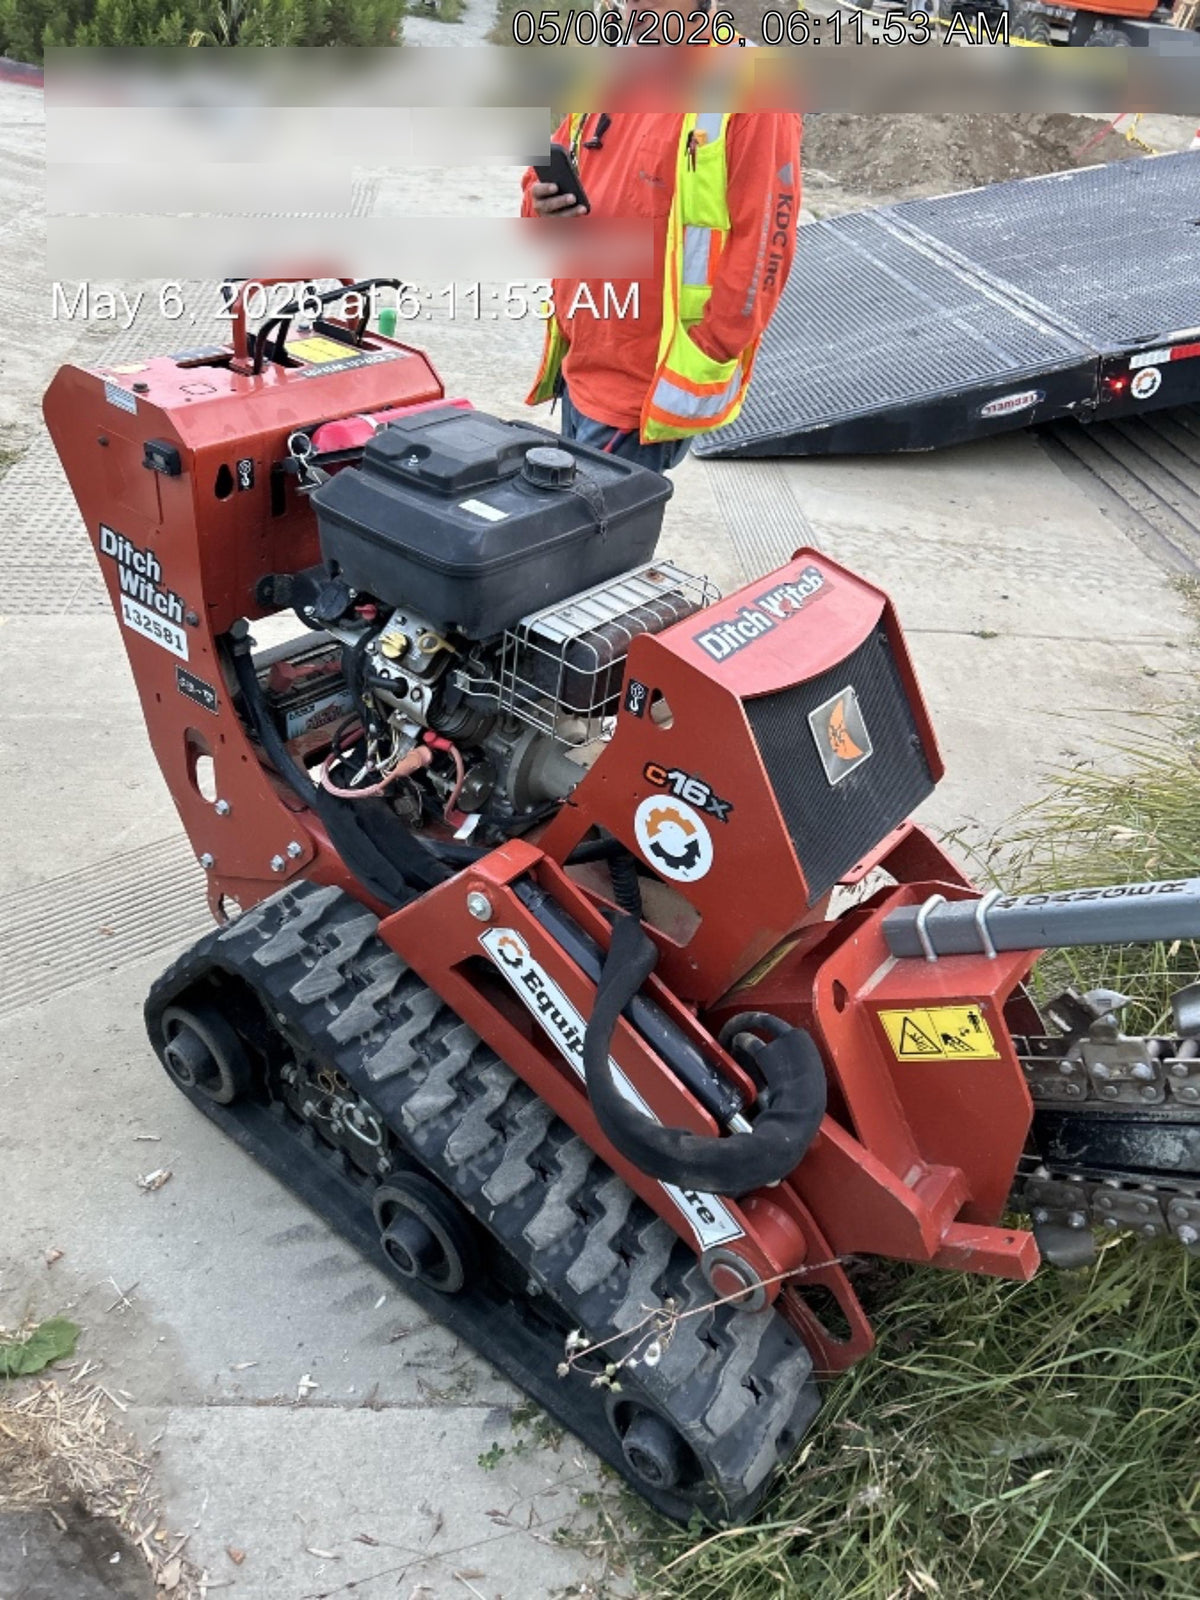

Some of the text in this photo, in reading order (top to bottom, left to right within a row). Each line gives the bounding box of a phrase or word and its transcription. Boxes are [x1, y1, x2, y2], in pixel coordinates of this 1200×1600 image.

[772, 194, 793, 247] KDC
[763, 254, 783, 291] Inc.
[100, 527, 161, 583] Ditch
[118, 565, 184, 624] Witch
[123, 602, 185, 652] 132581
[697, 607, 773, 662] Ditch
[1024, 879, 1188, 906] DANGER
